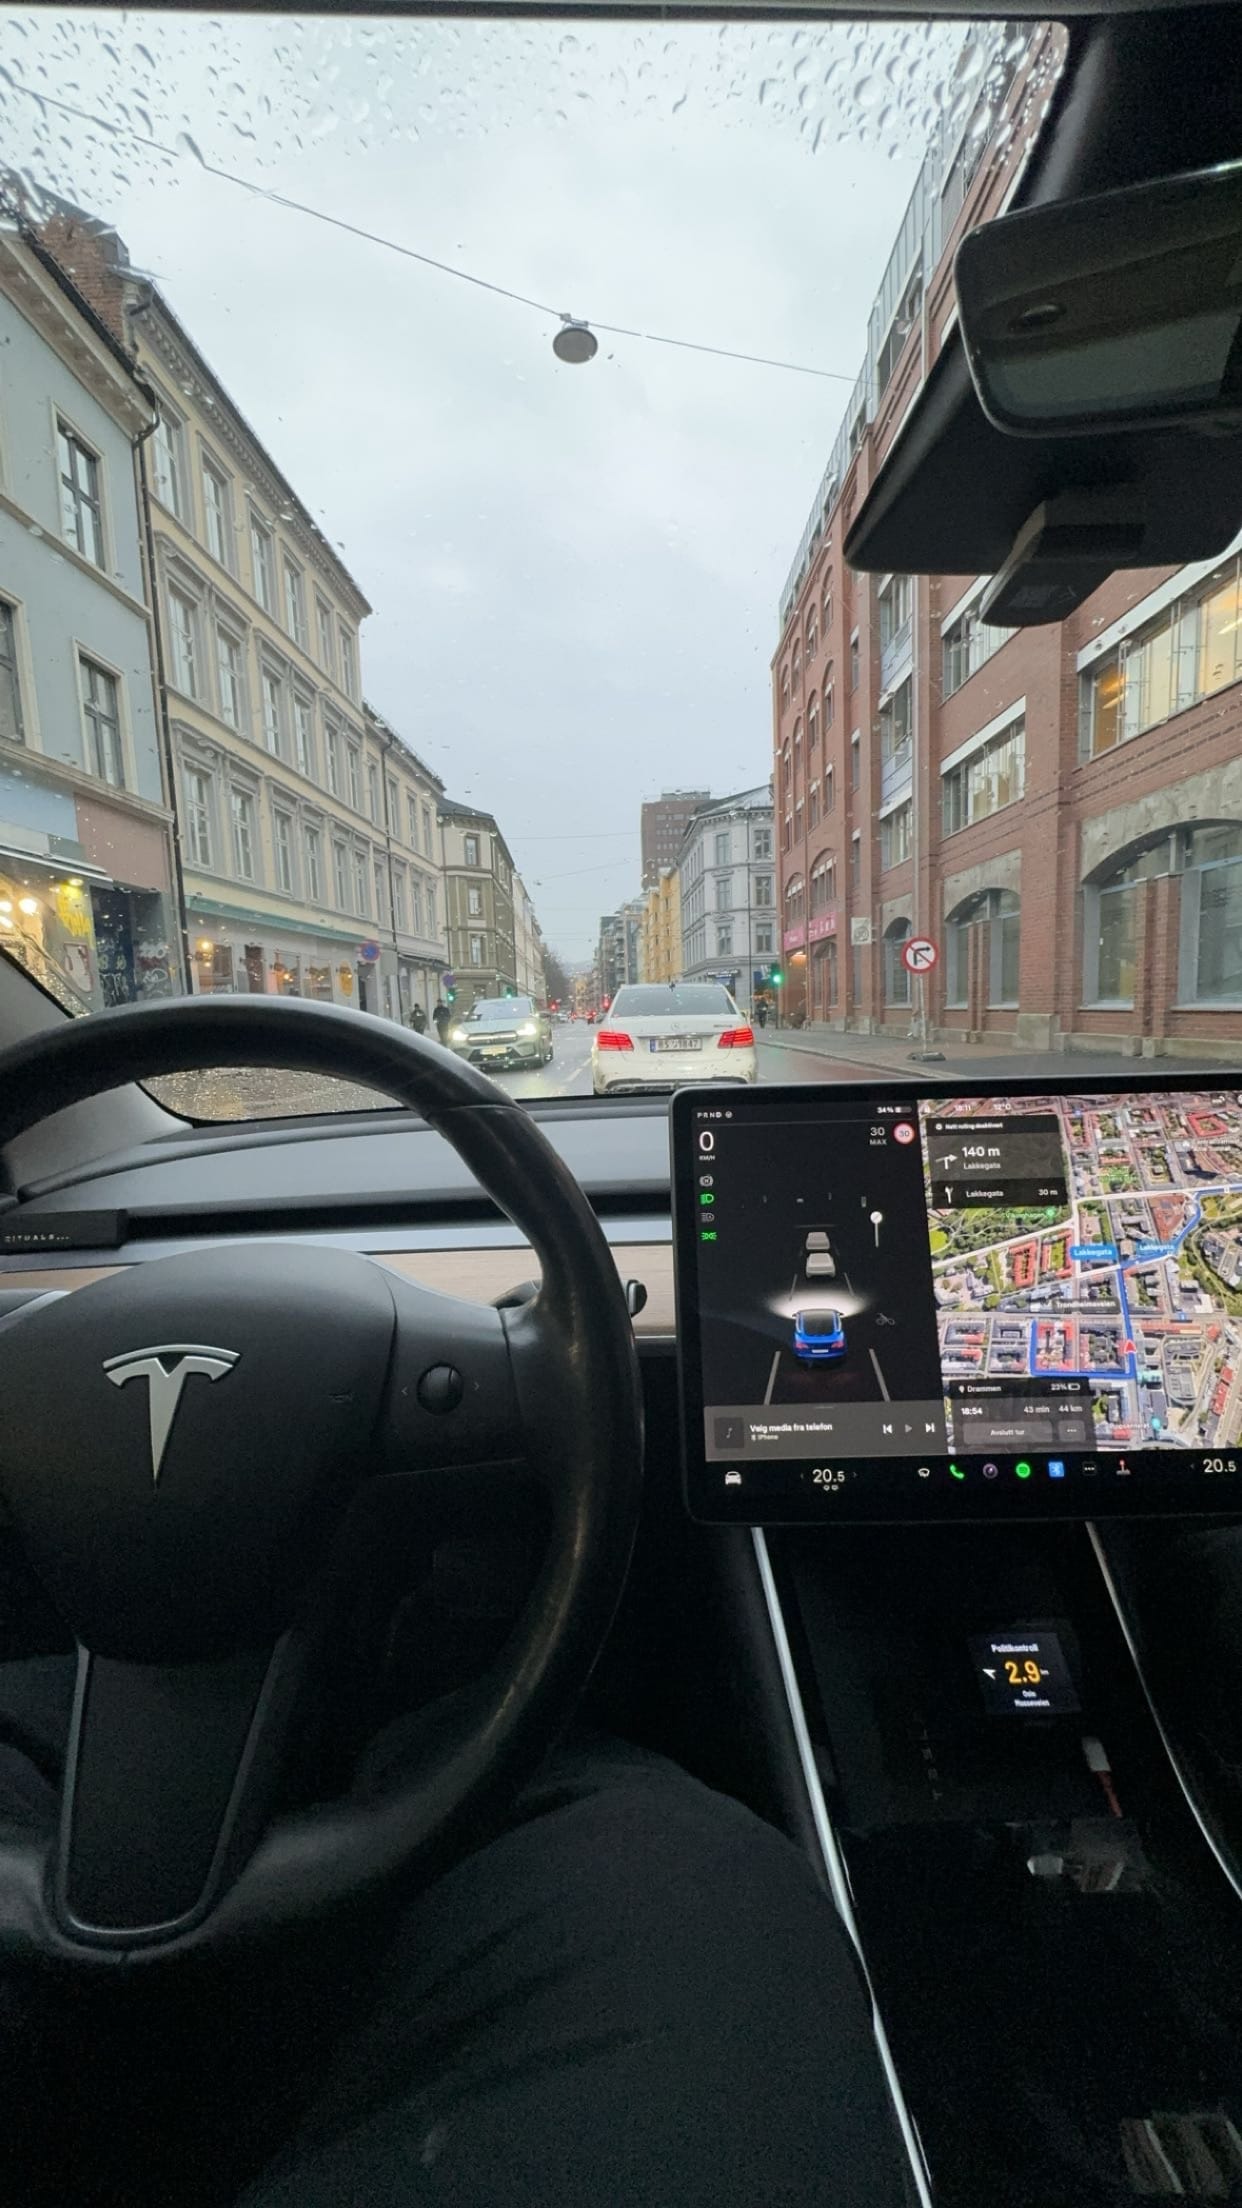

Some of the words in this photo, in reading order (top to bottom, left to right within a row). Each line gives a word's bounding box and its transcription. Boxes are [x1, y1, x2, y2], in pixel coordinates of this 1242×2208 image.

[870, 1126, 885, 1136] 30
[899, 1130, 910, 1138] 30
[699, 1131, 714, 1151] 0
[962, 1147, 985, 1158] 140
[988, 1147, 1001, 1156] m
[963, 1162, 1001, 1171] Lakkegata
[966, 1190, 1004, 1199] Lakkegata
[1039, 1188, 1048, 1196] 30
[1074, 1248, 1113, 1257] Lakkegata
[967, 1385, 1002, 1393] Drammen
[961, 1407, 983, 1415] 18:54
[1024, 1406, 1034, 1414] 43
[1070, 1404, 1083, 1412] km
[750, 1424, 768, 1434] Velg
[768, 1424, 792, 1432] media
[793, 1423, 805, 1431] fra
[805, 1422, 833, 1431] telefon
[1203, 1458, 1237, 1473] 20.5
[813, 1468, 846, 1483] 20.5
[1004, 1660, 1041, 1684] 2.9
